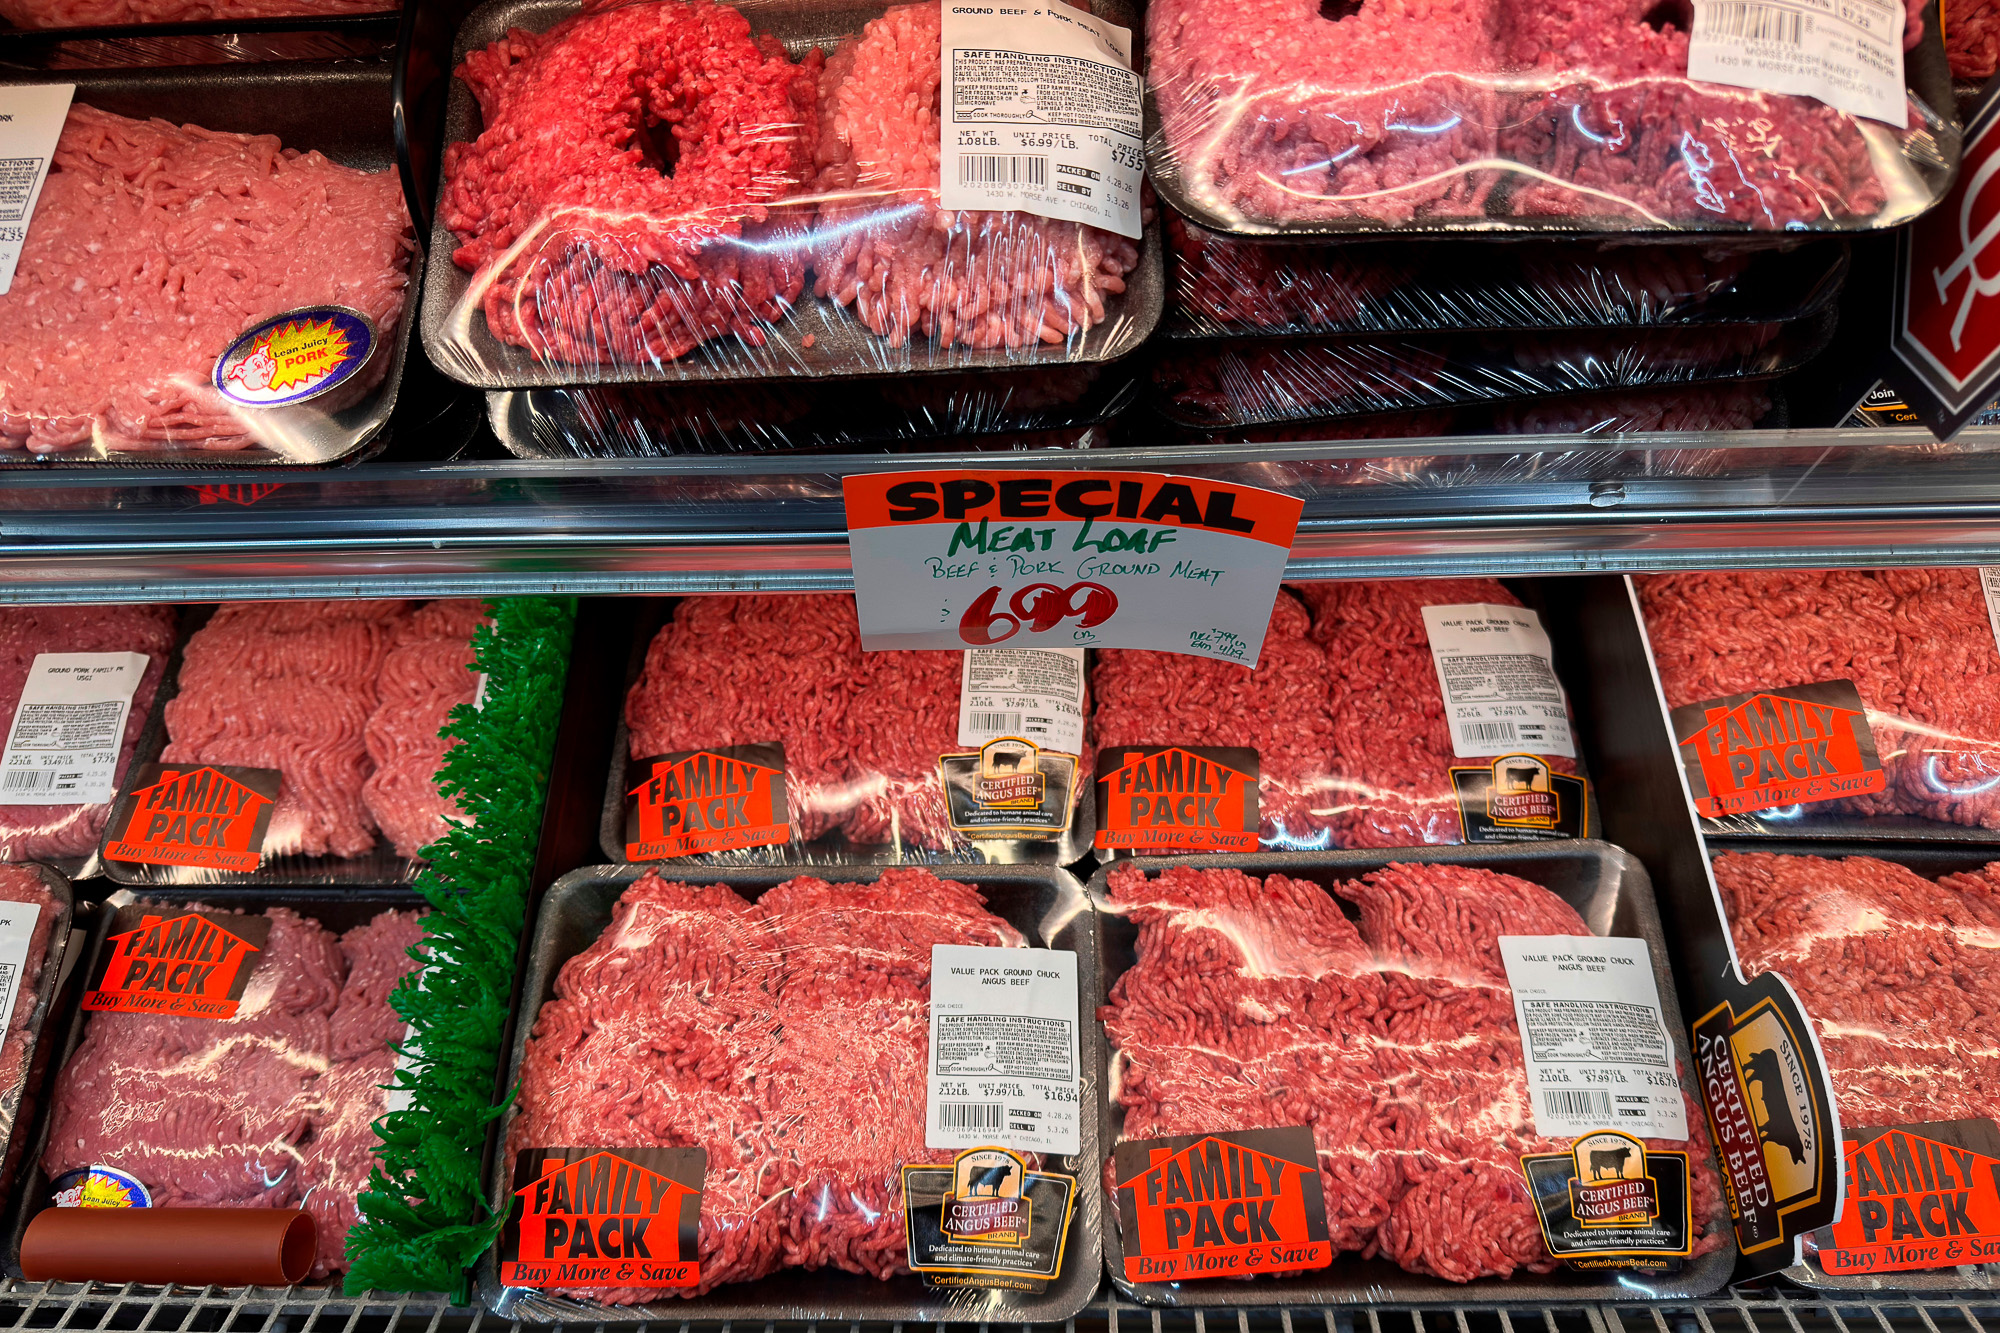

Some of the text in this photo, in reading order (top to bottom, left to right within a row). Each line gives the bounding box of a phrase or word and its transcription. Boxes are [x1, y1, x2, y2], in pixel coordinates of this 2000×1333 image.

[952, 7, 993, 15] GROUND
[1048, 9, 1073, 25] PORK
[1078, 22, 1101, 37] MEAT
[1105, 39, 1125, 58] LOAF
[963, 51, 1131, 79] SAFE HANDLING INSTRUCTIONS
[958, 138, 1000, 146] 1.08LB.
[1021, 139, 1079, 150] $6.99/LB.
[1088, 135, 1142, 158] TOTAL PRICE
[1111, 150, 1144, 171] $7.55
[1057, 165, 1100, 180] PACKED ON
[1057, 182, 1091, 196] SELL BY
[1106, 194, 1129, 210] 5.3.26
[273, 335, 329, 359] Lean Juicy
[284, 347, 329, 369] PORK
[1871, 389, 1895, 399] Join
[886, 479, 1256, 533] SPECIAL
[947, 517, 1178, 556] MEAT LOAF
[925, 556, 979, 579] BEEF
[1007, 555, 1064, 577] PORK
[1077, 556, 1160, 577] GROUND
[1170, 560, 1225, 586] MEAT
[1706, 697, 1838, 755] FAMILY
[1119, 752, 1234, 794] FAMILY
[1728, 739, 1839, 789] PACK
[649, 755, 759, 805] FAMILY
[146, 770, 254, 815] FAMILY
[1710, 775, 1874, 812] Buy More & Save
[662, 795, 751, 837] PACK
[1130, 794, 1221, 829] PACK
[144, 814, 234, 847] PACK
[1103, 830, 1249, 848] Buy More & Save
[636, 828, 780, 857] Buy More & Save
[113, 844, 250, 866] Buy More & Save
[124, 917, 239, 963] FAMILY
[1522, 954, 1634, 966] VALUE PACK GROUND CHUCK
[1587, 965, 1606, 973] BEEF
[121, 961, 217, 995] PACK
[951, 967, 1060, 979] VALUE PACK GROUND CHUCK
[982, 977, 1030, 986] ANGUS BEEF
[91, 992, 228, 1014] Buy More & Save
[1009, 1018, 1065, 1027] INSTRUCTIONS
[1539, 1074, 1571, 1082] 2.10LB.
[1586, 1075, 1629, 1084] $7.99/LB.
[1647, 1076, 1678, 1088] $16.78
[1698, 1034, 1734, 1143] ANGUS
[939, 1088, 970, 1096] 2.12LB.
[984, 1089, 1025, 1097] $7.99/LB.
[1044, 1091, 1078, 1103] $16.94
[1779, 1040, 1812, 1150] SINCE 1978
[1713, 1034, 1769, 1208] CERTIFIED
[971, 1155, 1010, 1164] SINCE 1978
[534, 1156, 672, 1215] FAMILY
[1147, 1141, 1286, 1208] FAMILY
[1713, 1144, 1738, 1216] BRAND
[83, 1194, 121, 1207] Lean Juicy
[1579, 1183, 1645, 1202] CERTIFIED
[951, 1202, 1019, 1217] CERTIFIED
[1577, 1199, 1621, 1216] ANGUS
[1857, 1191, 1980, 1243] PACK
[945, 1215, 990, 1232] ANGUS
[1164, 1198, 1279, 1251] PACK
[545, 1218, 652, 1259] PACK
[928, 1245, 963, 1254] Dedicated
[973, 1247, 1001, 1255] humane
[1002, 1248, 1024, 1257] animal
[934, 1254, 947, 1262] and
[949, 1255, 1001, 1267] climate-friendly
[1138, 1244, 1319, 1276] Buy More & Save
[1835, 1249, 1877, 1270] Buy
[1883, 1243, 1938, 1264] More
[1945, 1241, 1964, 1258] &
[513, 1263, 688, 1285] Buy More & Save
